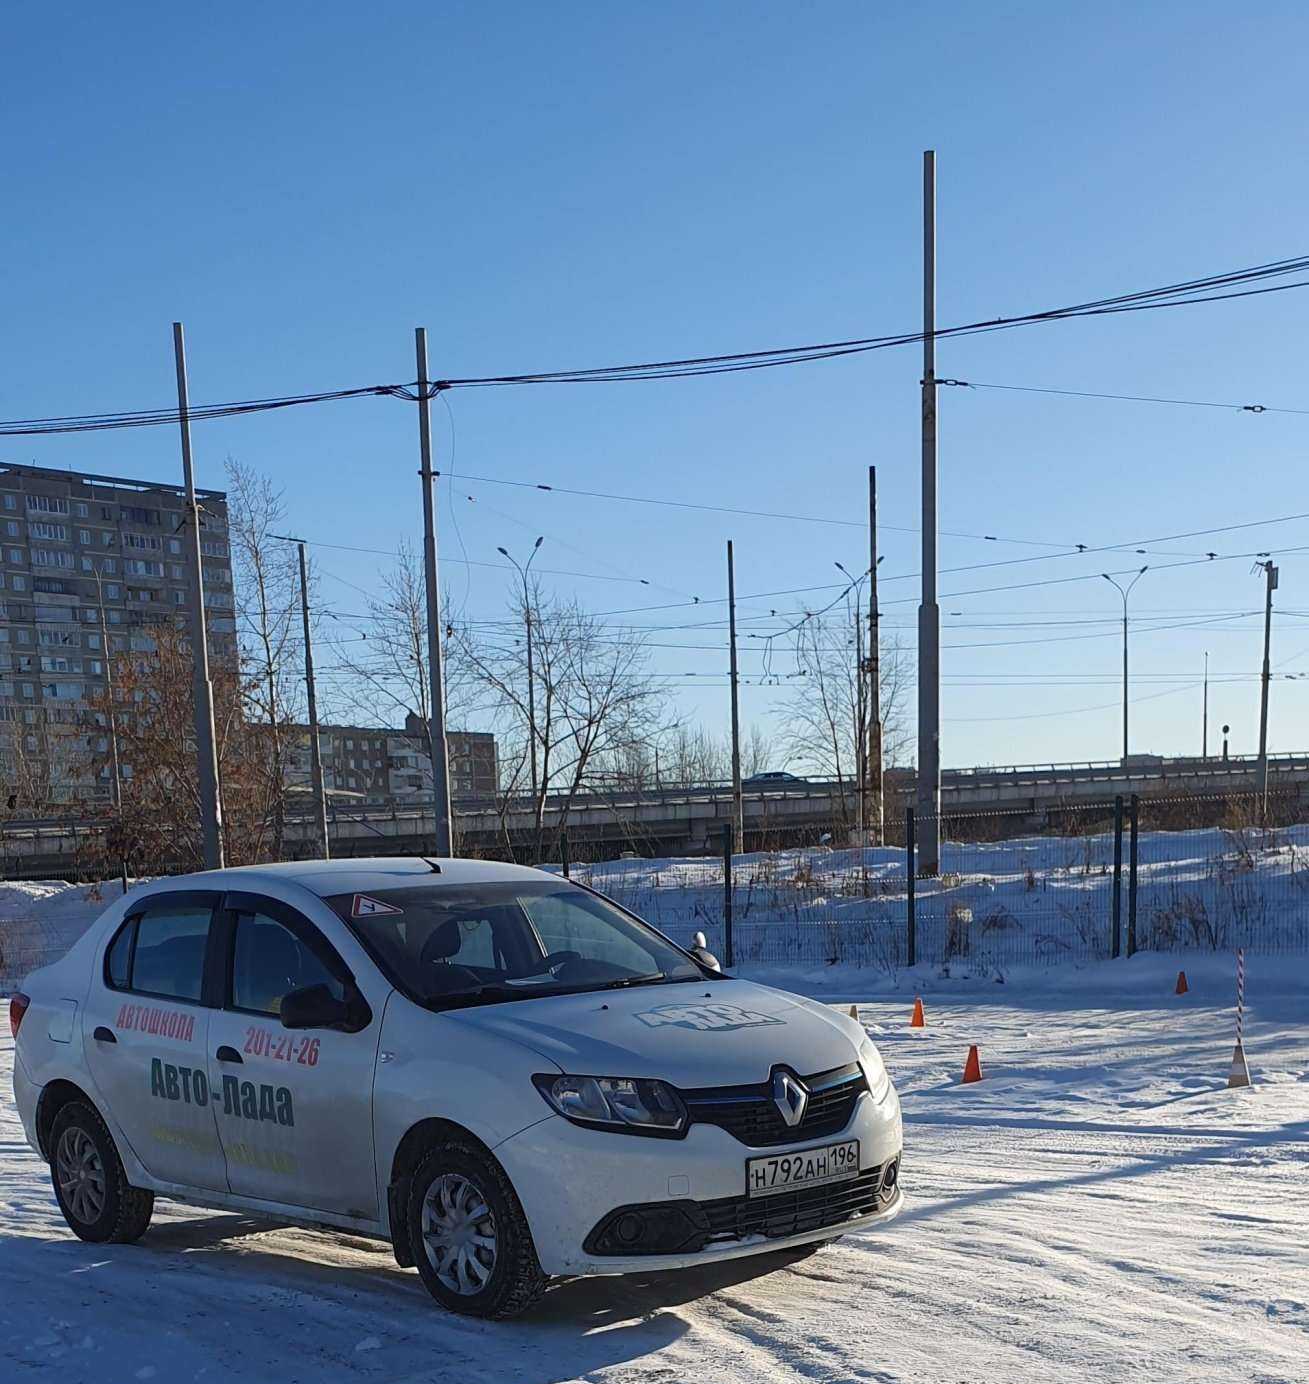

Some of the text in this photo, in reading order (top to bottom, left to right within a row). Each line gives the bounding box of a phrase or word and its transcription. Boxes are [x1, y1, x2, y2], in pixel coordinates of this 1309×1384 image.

[116, 1004, 320, 1066] АВТОШКОЛА 201-21-26
[830, 1144, 854, 1166] 196
